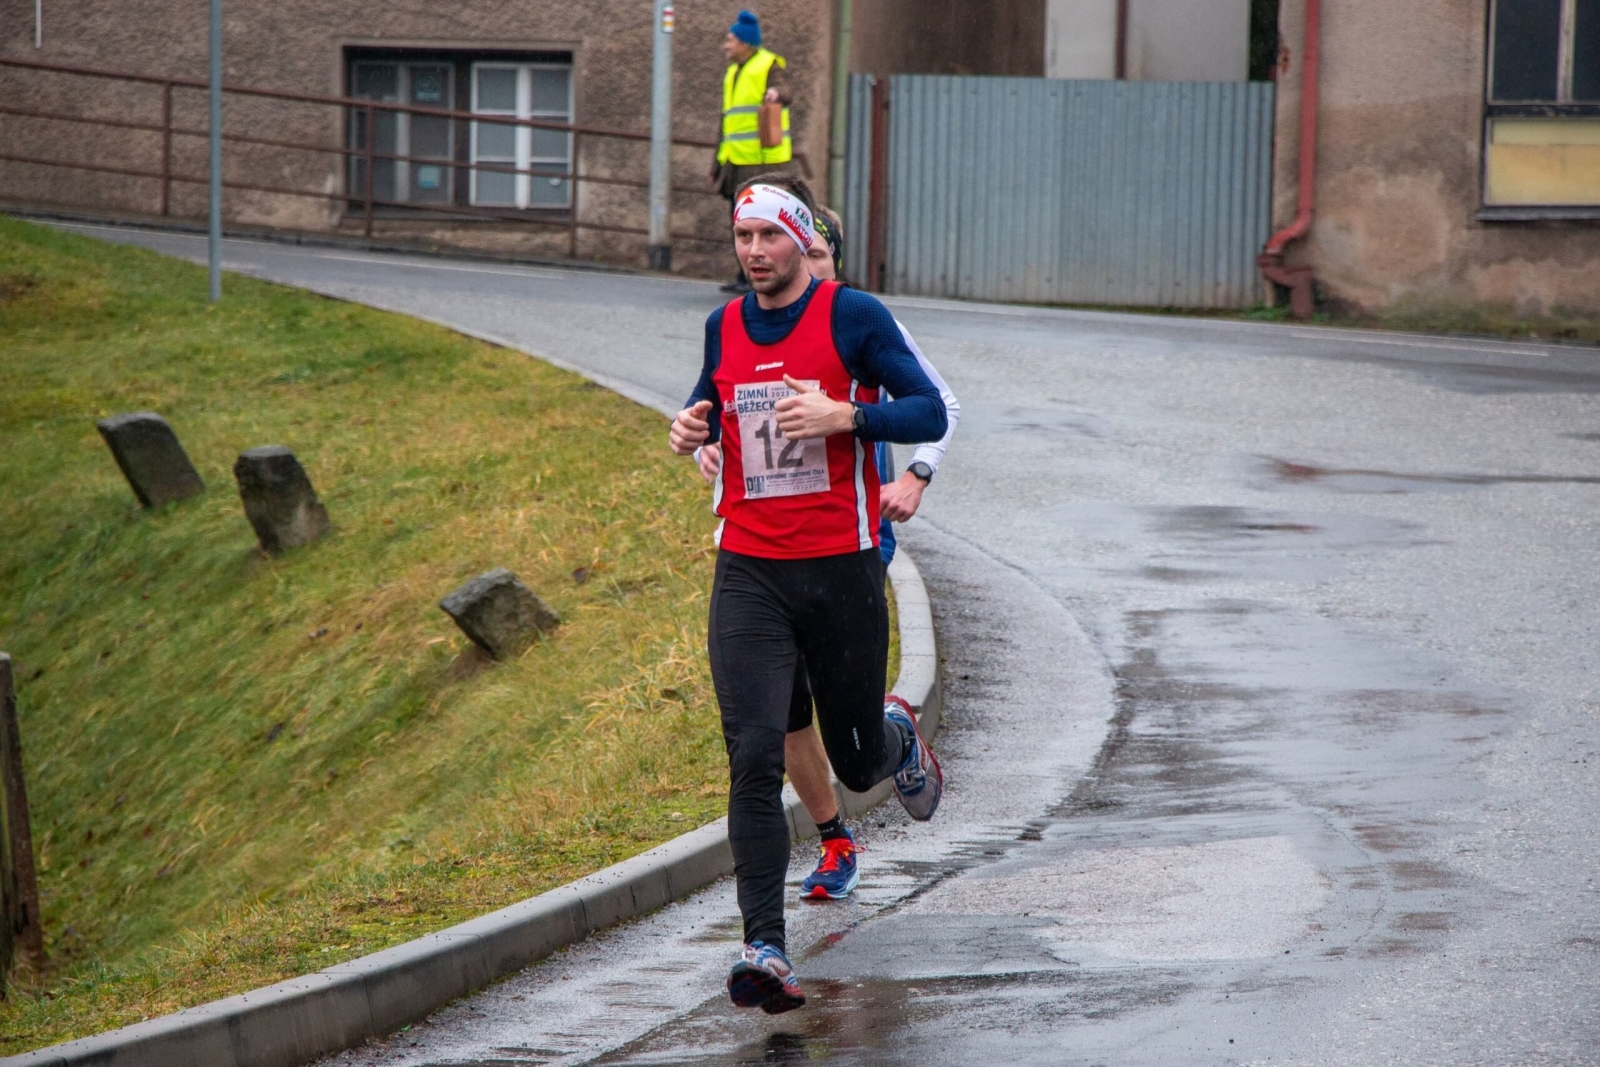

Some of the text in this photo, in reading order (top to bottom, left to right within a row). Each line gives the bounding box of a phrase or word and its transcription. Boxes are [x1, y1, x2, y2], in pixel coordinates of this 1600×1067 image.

[737, 386, 769, 400] ZIMNÍ
[738, 400, 776, 414] BĚŽECK
[755, 419, 803, 470] 12
